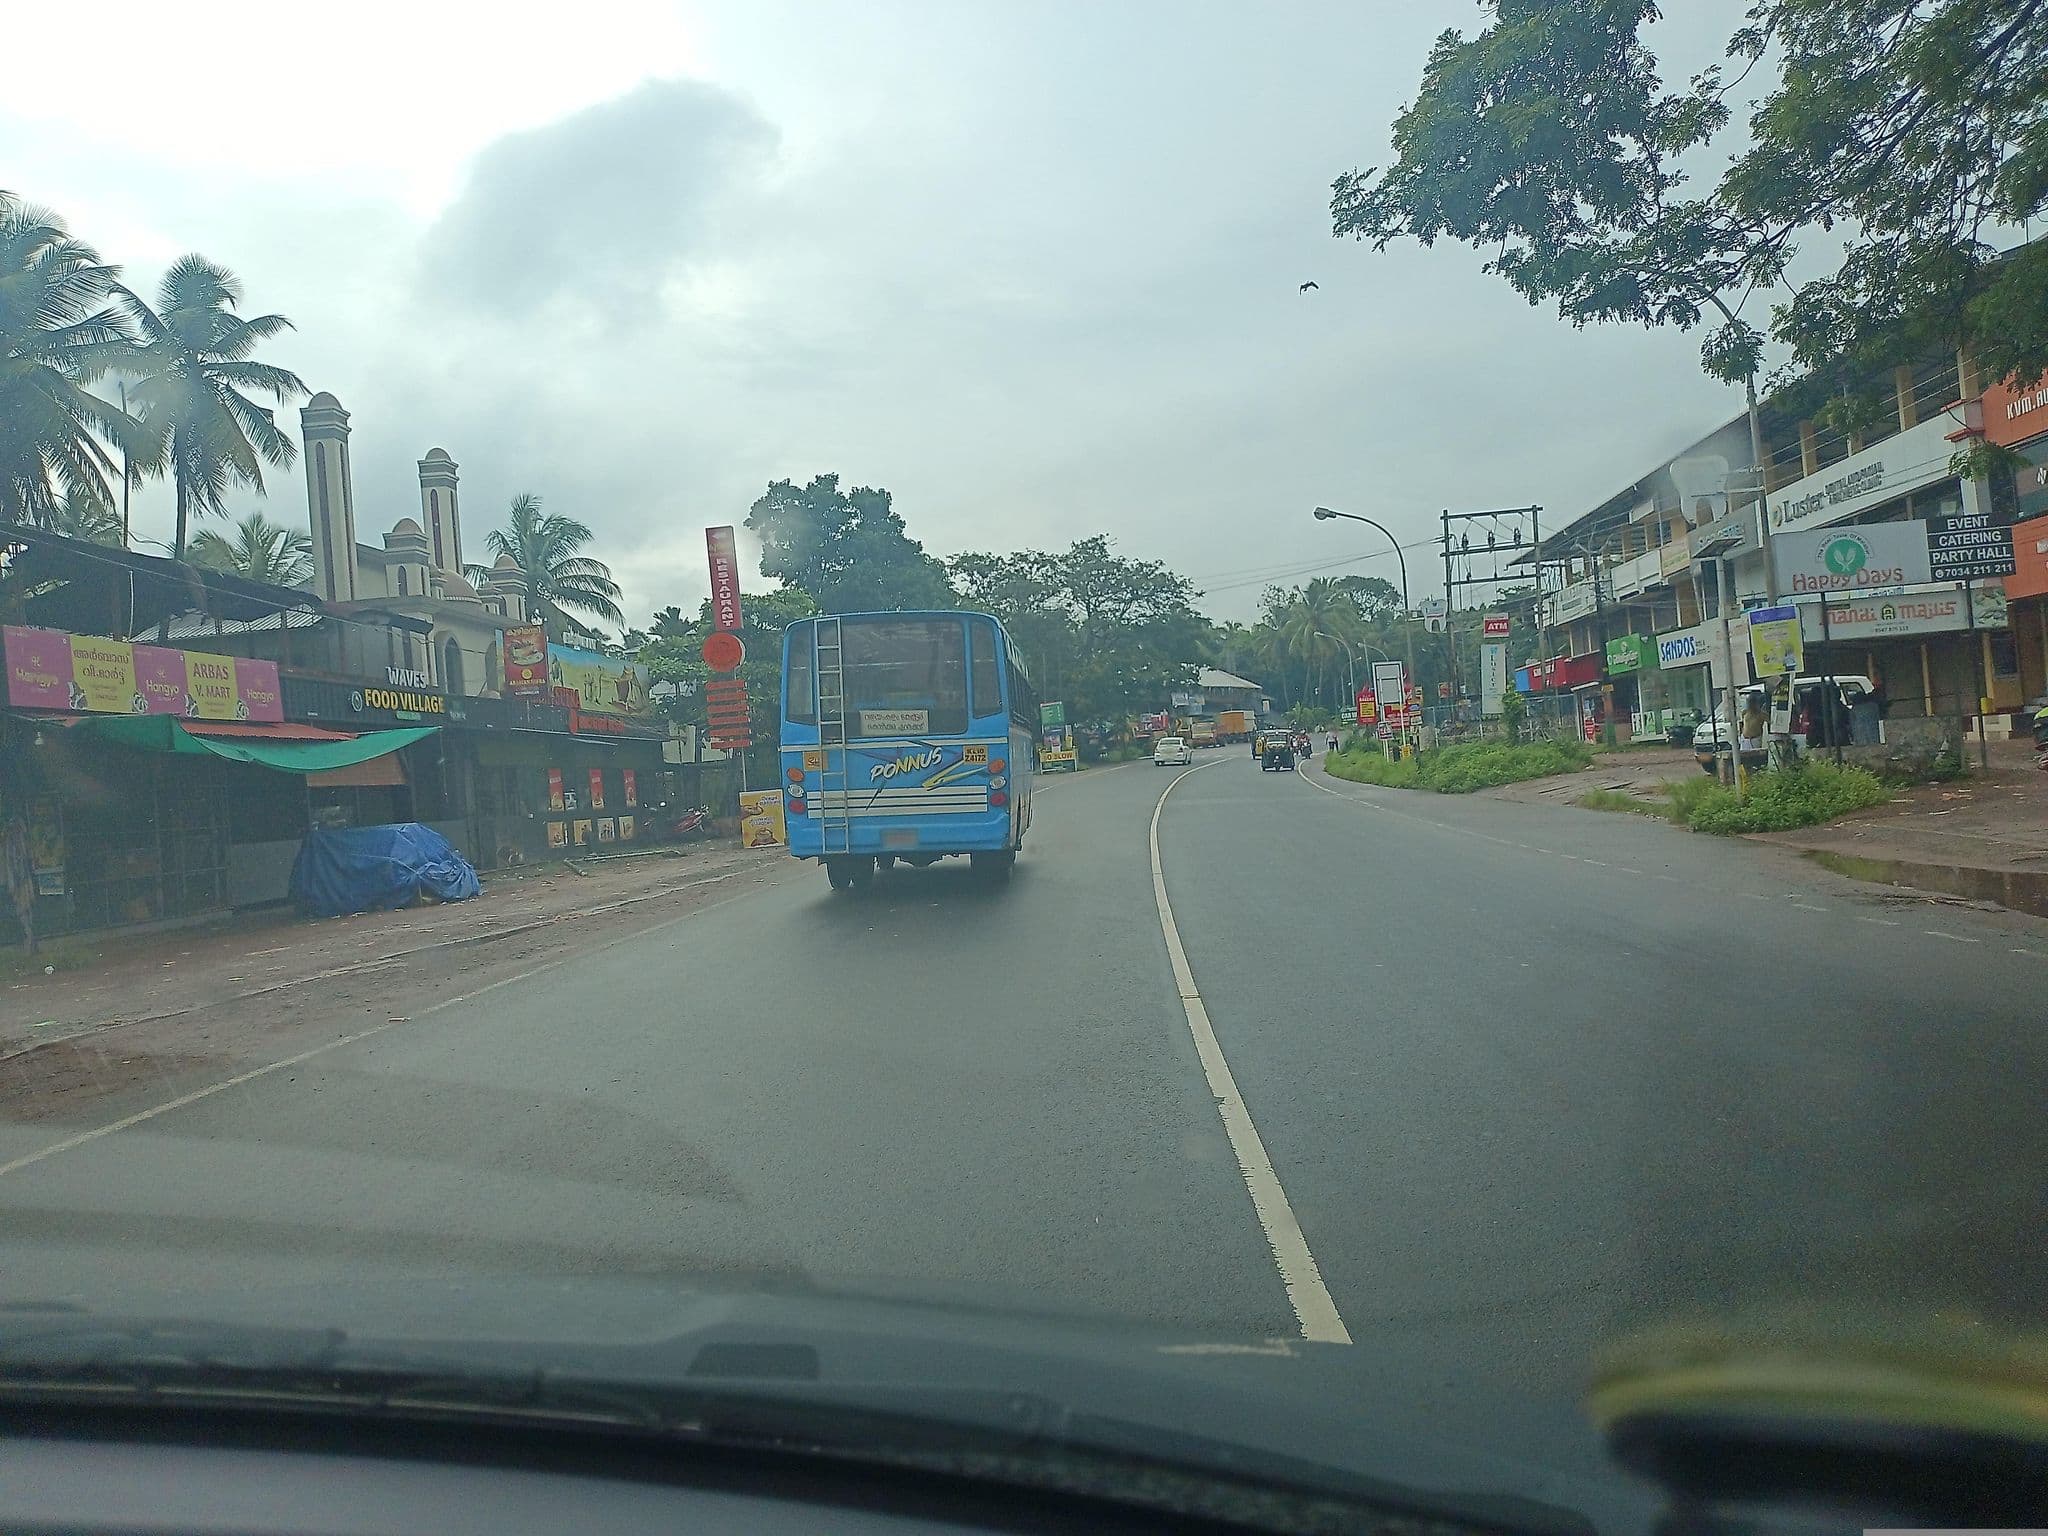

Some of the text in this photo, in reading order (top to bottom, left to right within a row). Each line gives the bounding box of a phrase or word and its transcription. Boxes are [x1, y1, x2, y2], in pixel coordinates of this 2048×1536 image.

[1947, 515, 1989, 530] EVENT
[1939, 530, 2002, 547] CATERING
[1932, 546, 2011, 564] PARTY HALL
[1945, 563, 2012, 577] 7034 211 211
[1792, 567, 1903, 592] Happy Days
[716, 558, 734, 627] RESTAURANT
[1487, 622, 1508, 631] ATM
[1660, 635, 1697, 661] SANDOS
[193, 662, 229, 681] ARBAS
[386, 666, 427, 689] WAVES
[145, 679, 179, 697] Hangyo
[207, 685, 230, 699] MART
[365, 688, 445, 713] FOOD VILLAGE
[870, 747, 942, 782] PONNUS
